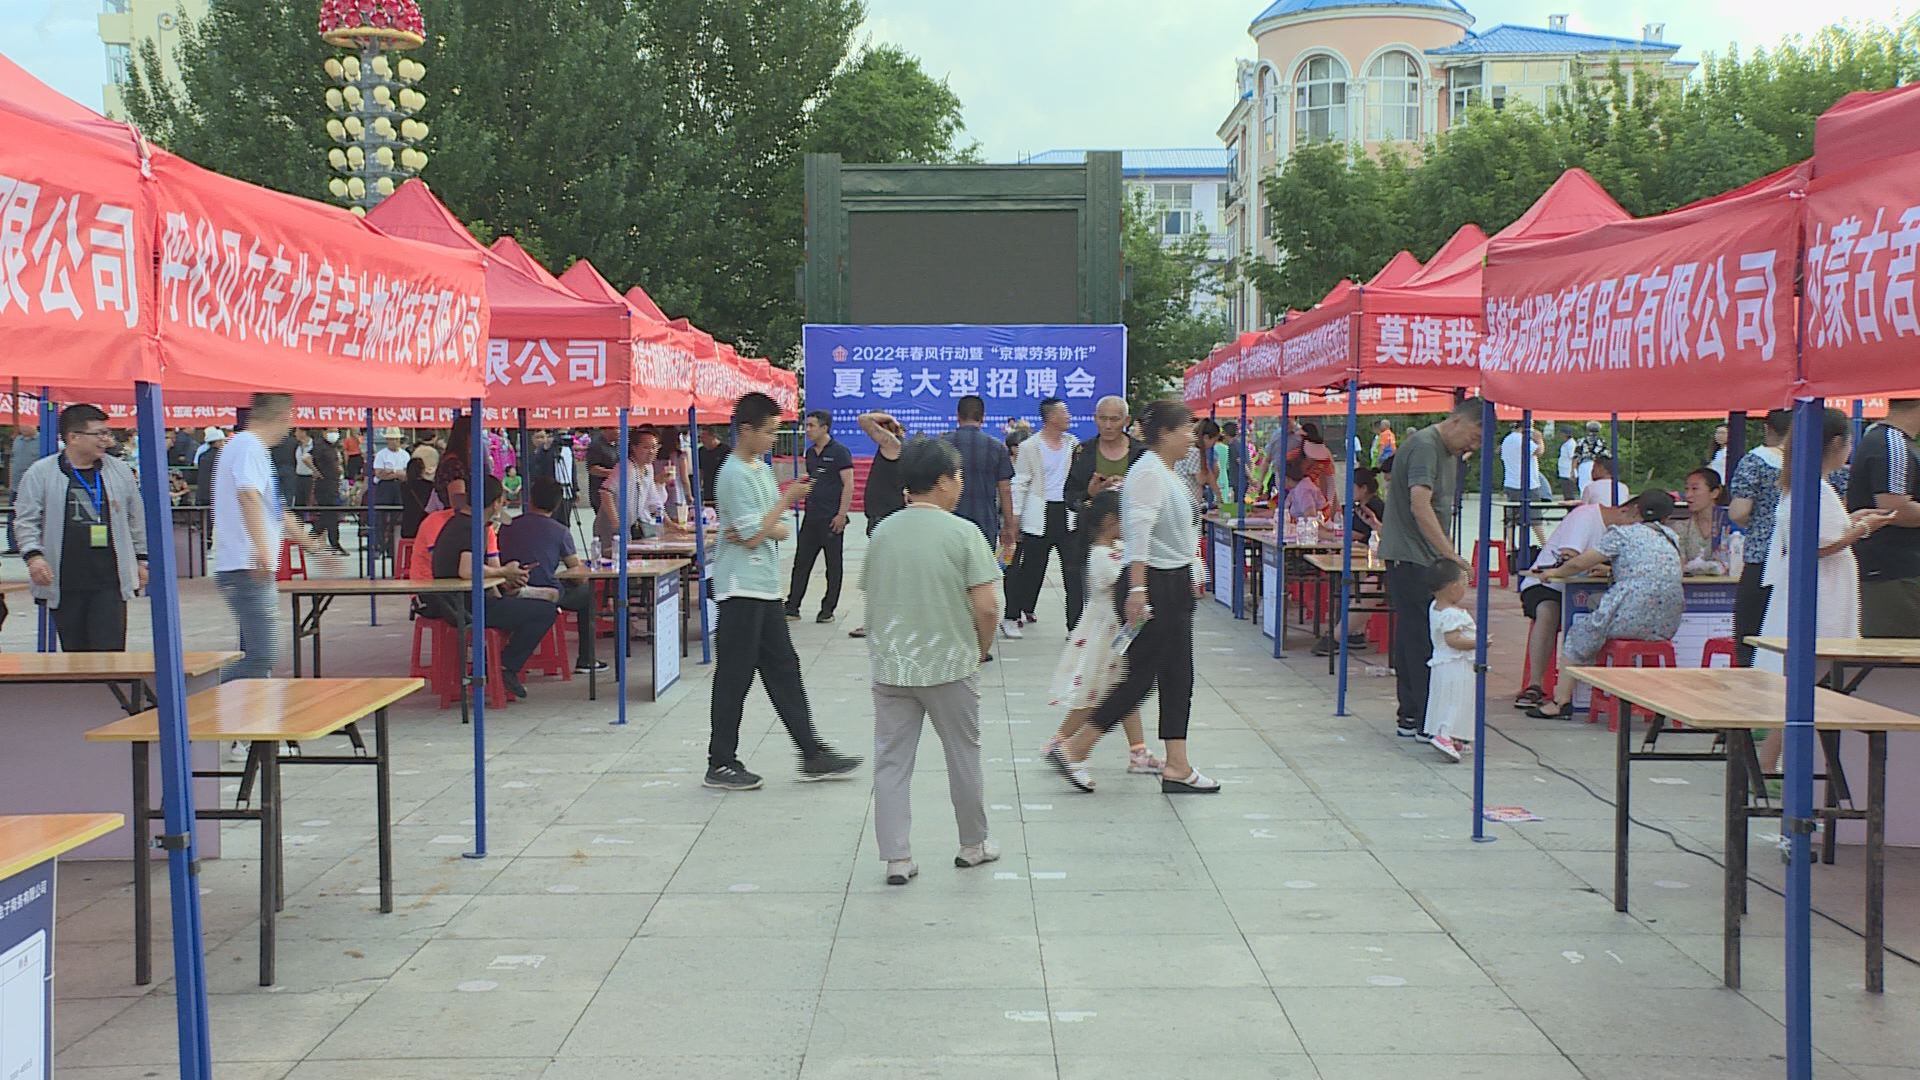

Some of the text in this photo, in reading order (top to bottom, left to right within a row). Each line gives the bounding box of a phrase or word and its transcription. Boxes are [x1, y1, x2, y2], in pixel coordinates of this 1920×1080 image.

[832, 366, 1096, 399] 夏季大型招聘会
